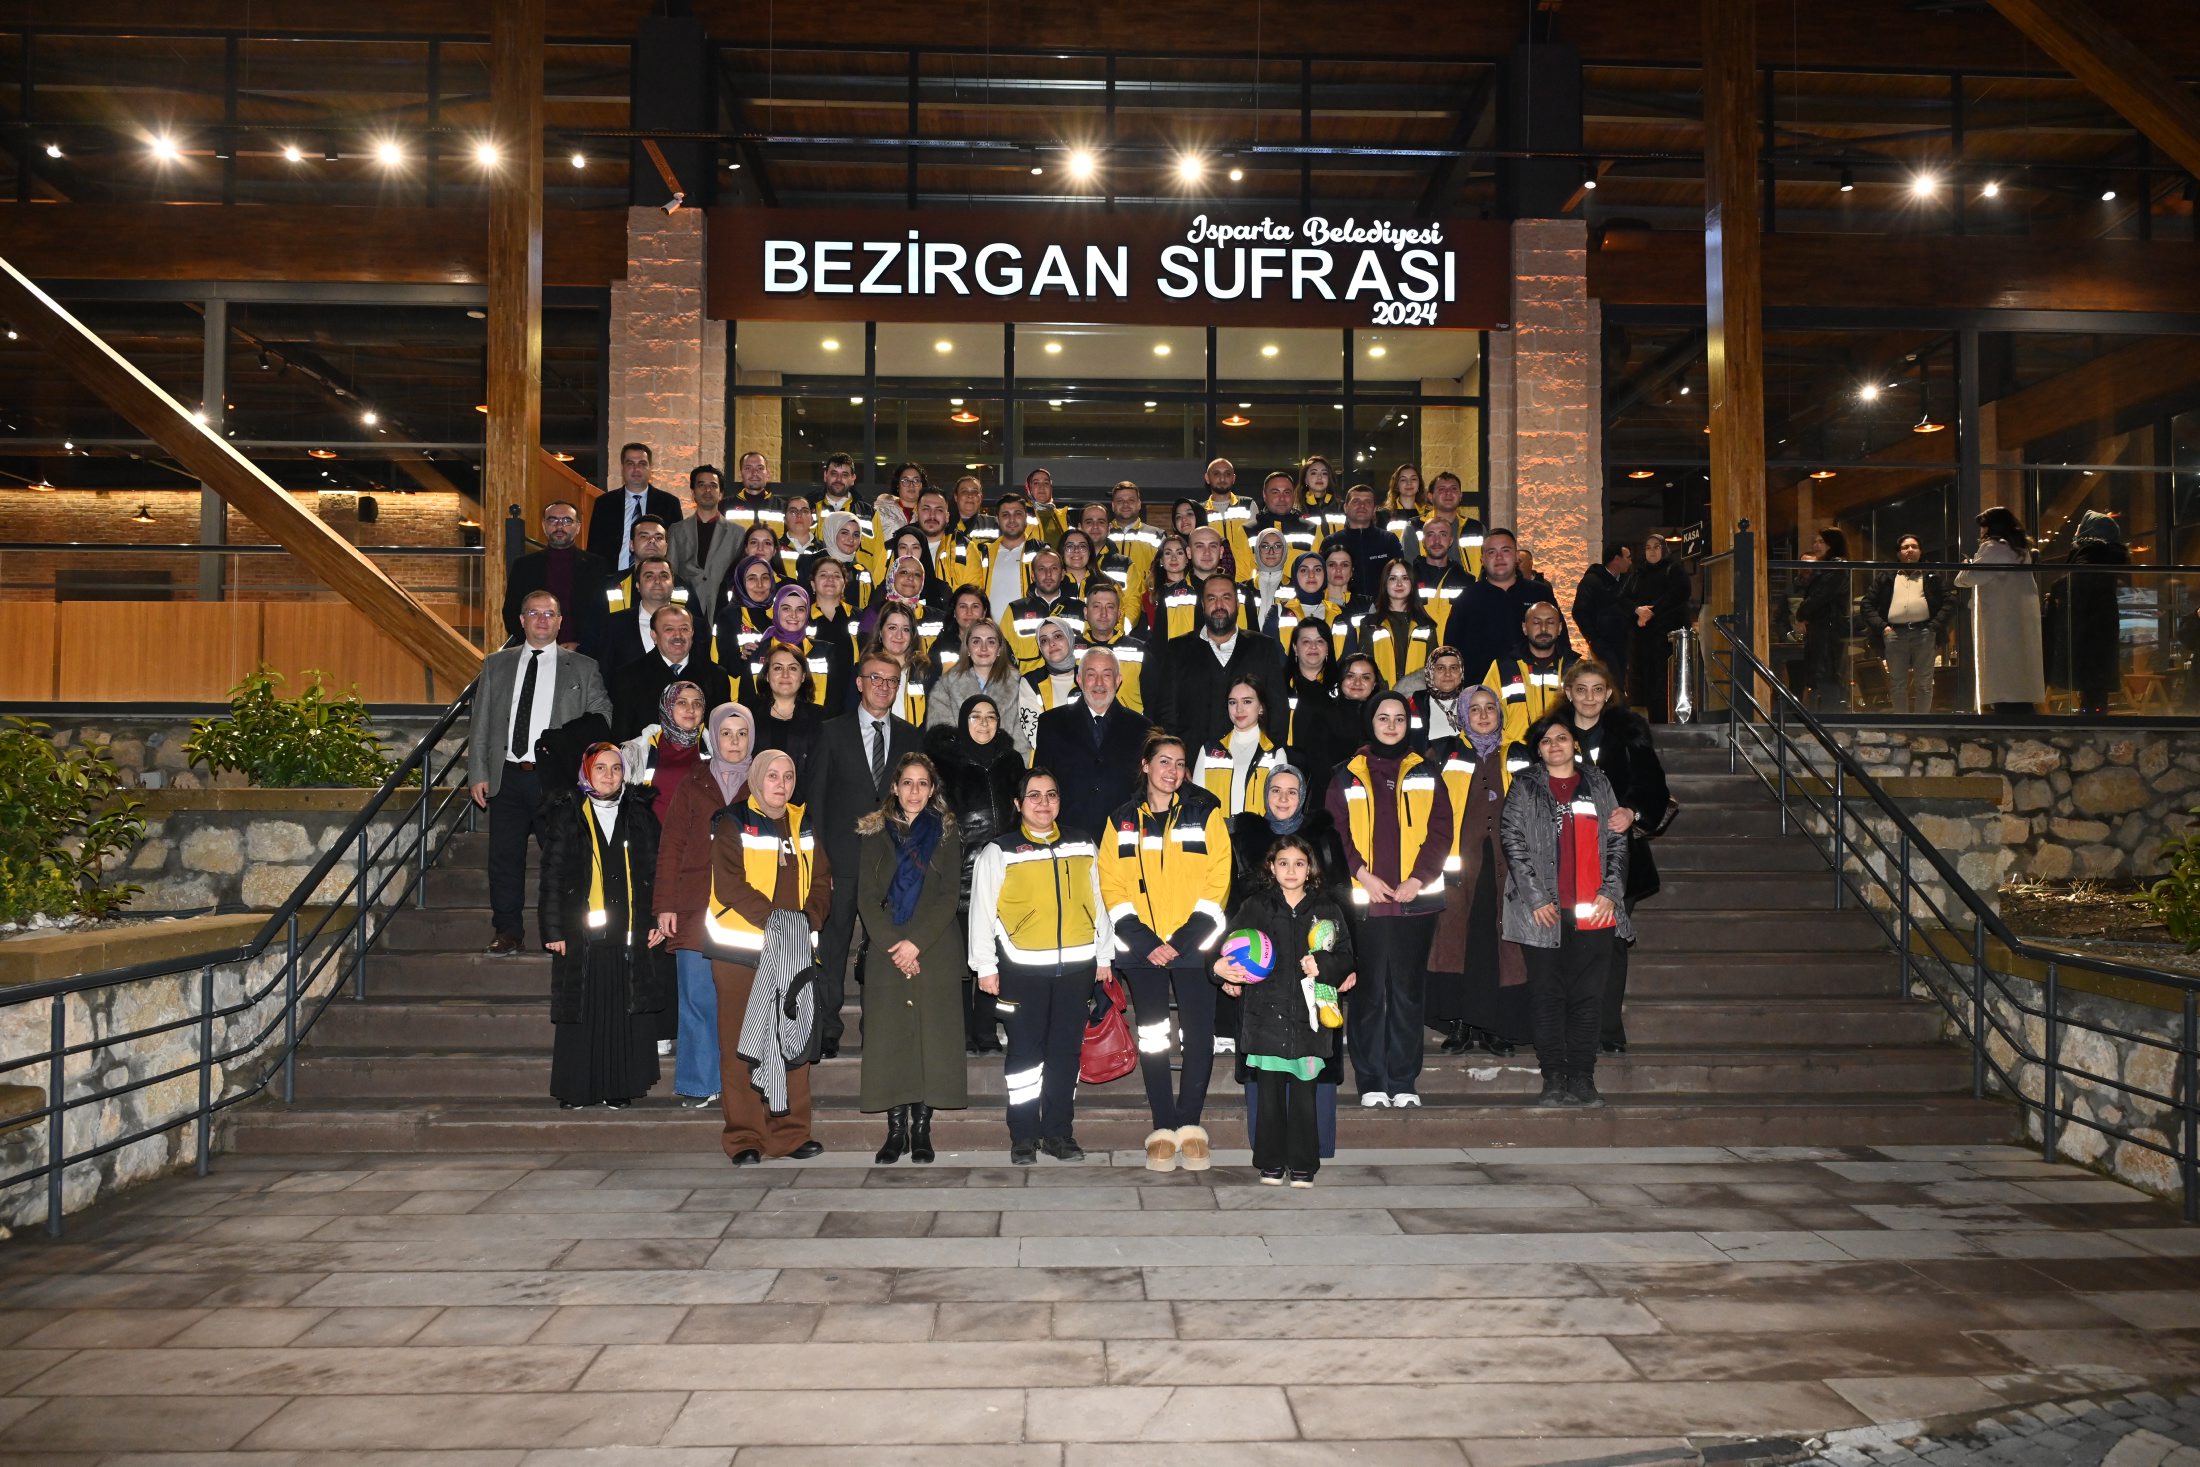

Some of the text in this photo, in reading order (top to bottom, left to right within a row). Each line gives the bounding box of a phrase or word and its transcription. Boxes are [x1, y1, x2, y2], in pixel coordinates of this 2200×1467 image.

[1187, 215, 1444, 251] Isparta Belediyesi
[764, 230, 1455, 302] BEZİRGAN SUFRASI
[1372, 302, 1438, 326] 2024
[1683, 529, 1700, 543] KASA
